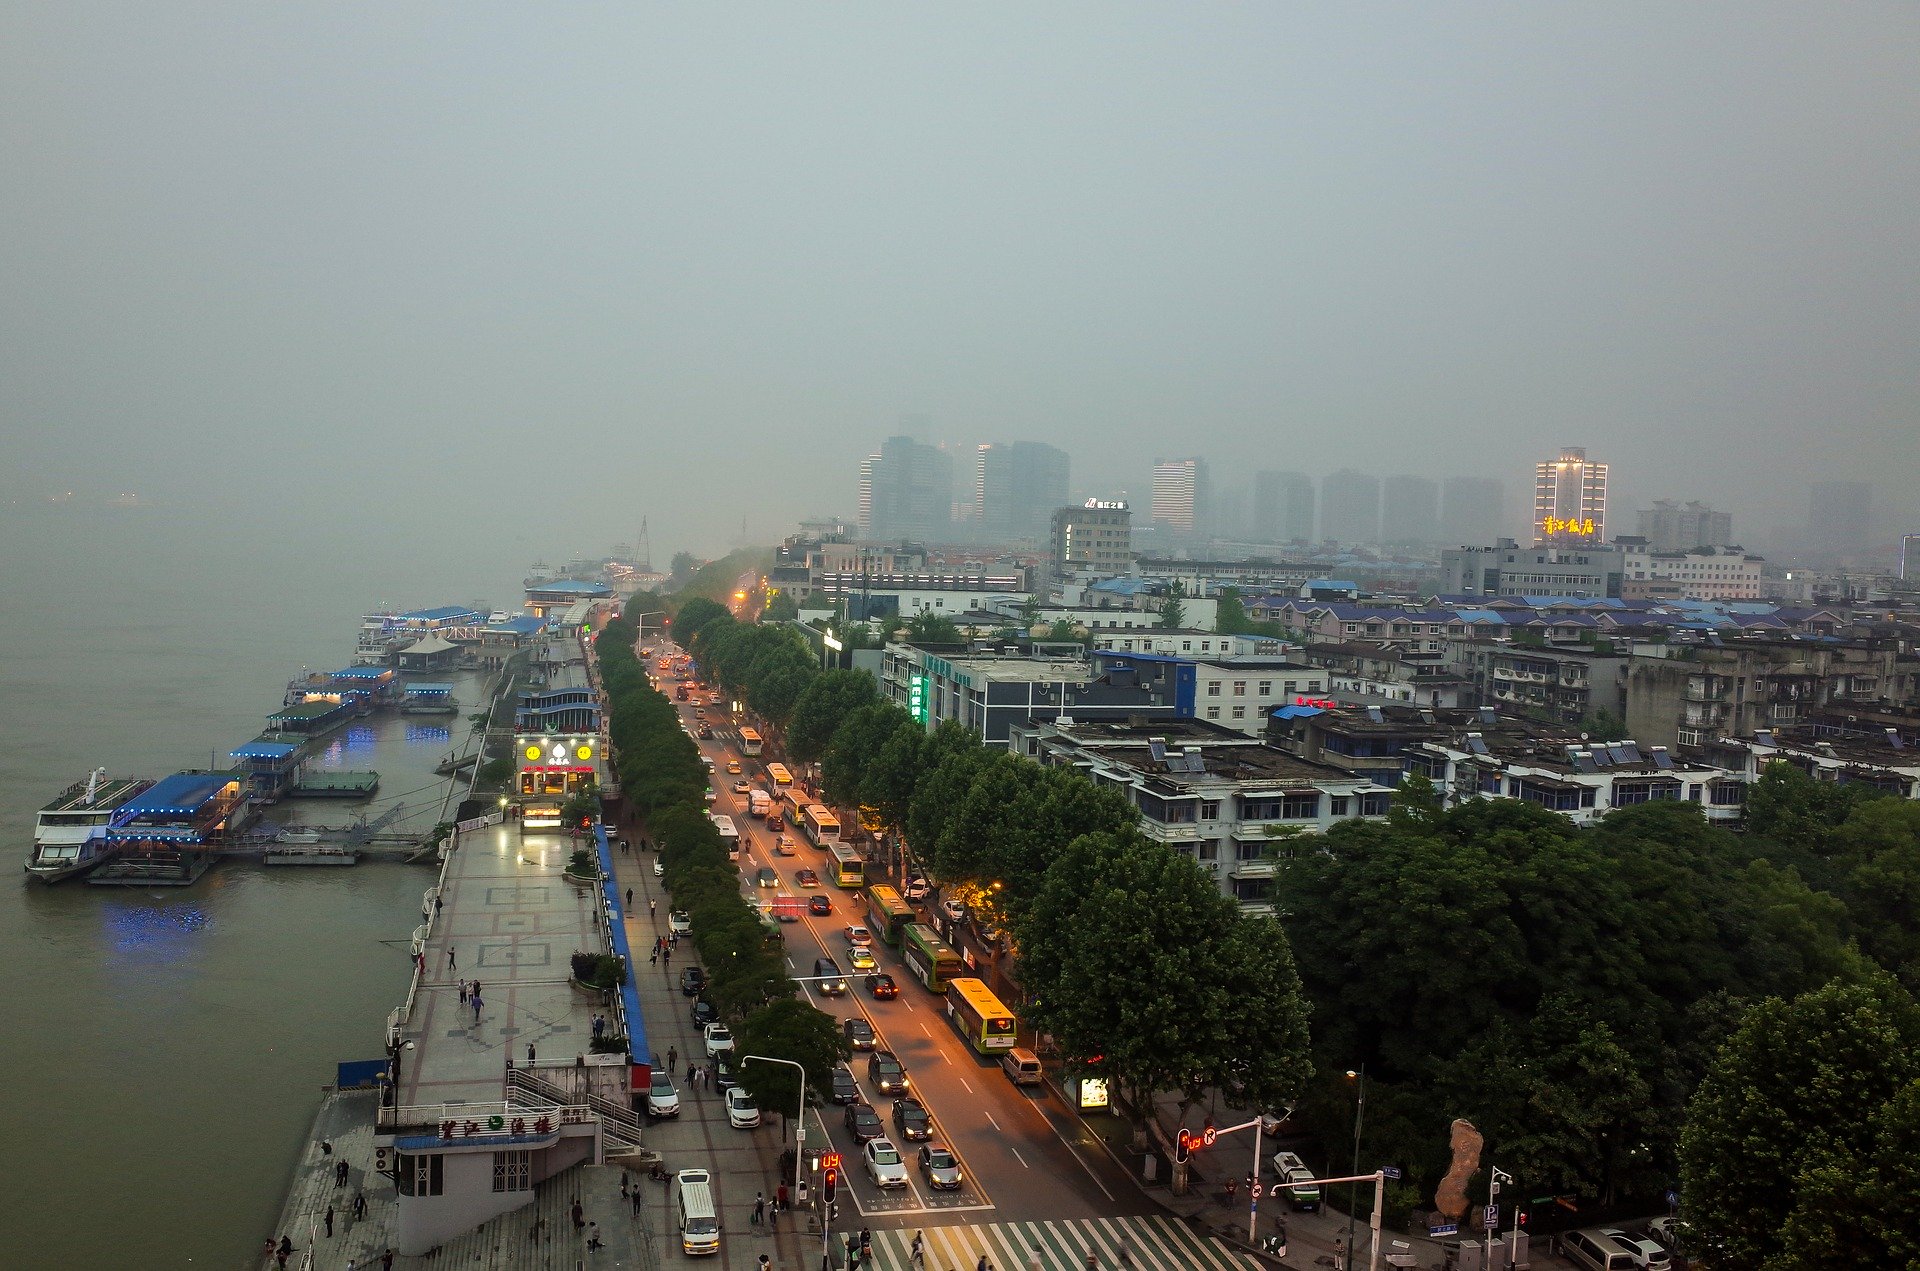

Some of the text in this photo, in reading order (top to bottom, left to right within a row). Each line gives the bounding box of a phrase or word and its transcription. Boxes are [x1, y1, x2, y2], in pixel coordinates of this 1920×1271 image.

[910, 676, 922, 721] 城市便捷
[1486, 1206, 1496, 1220] P
